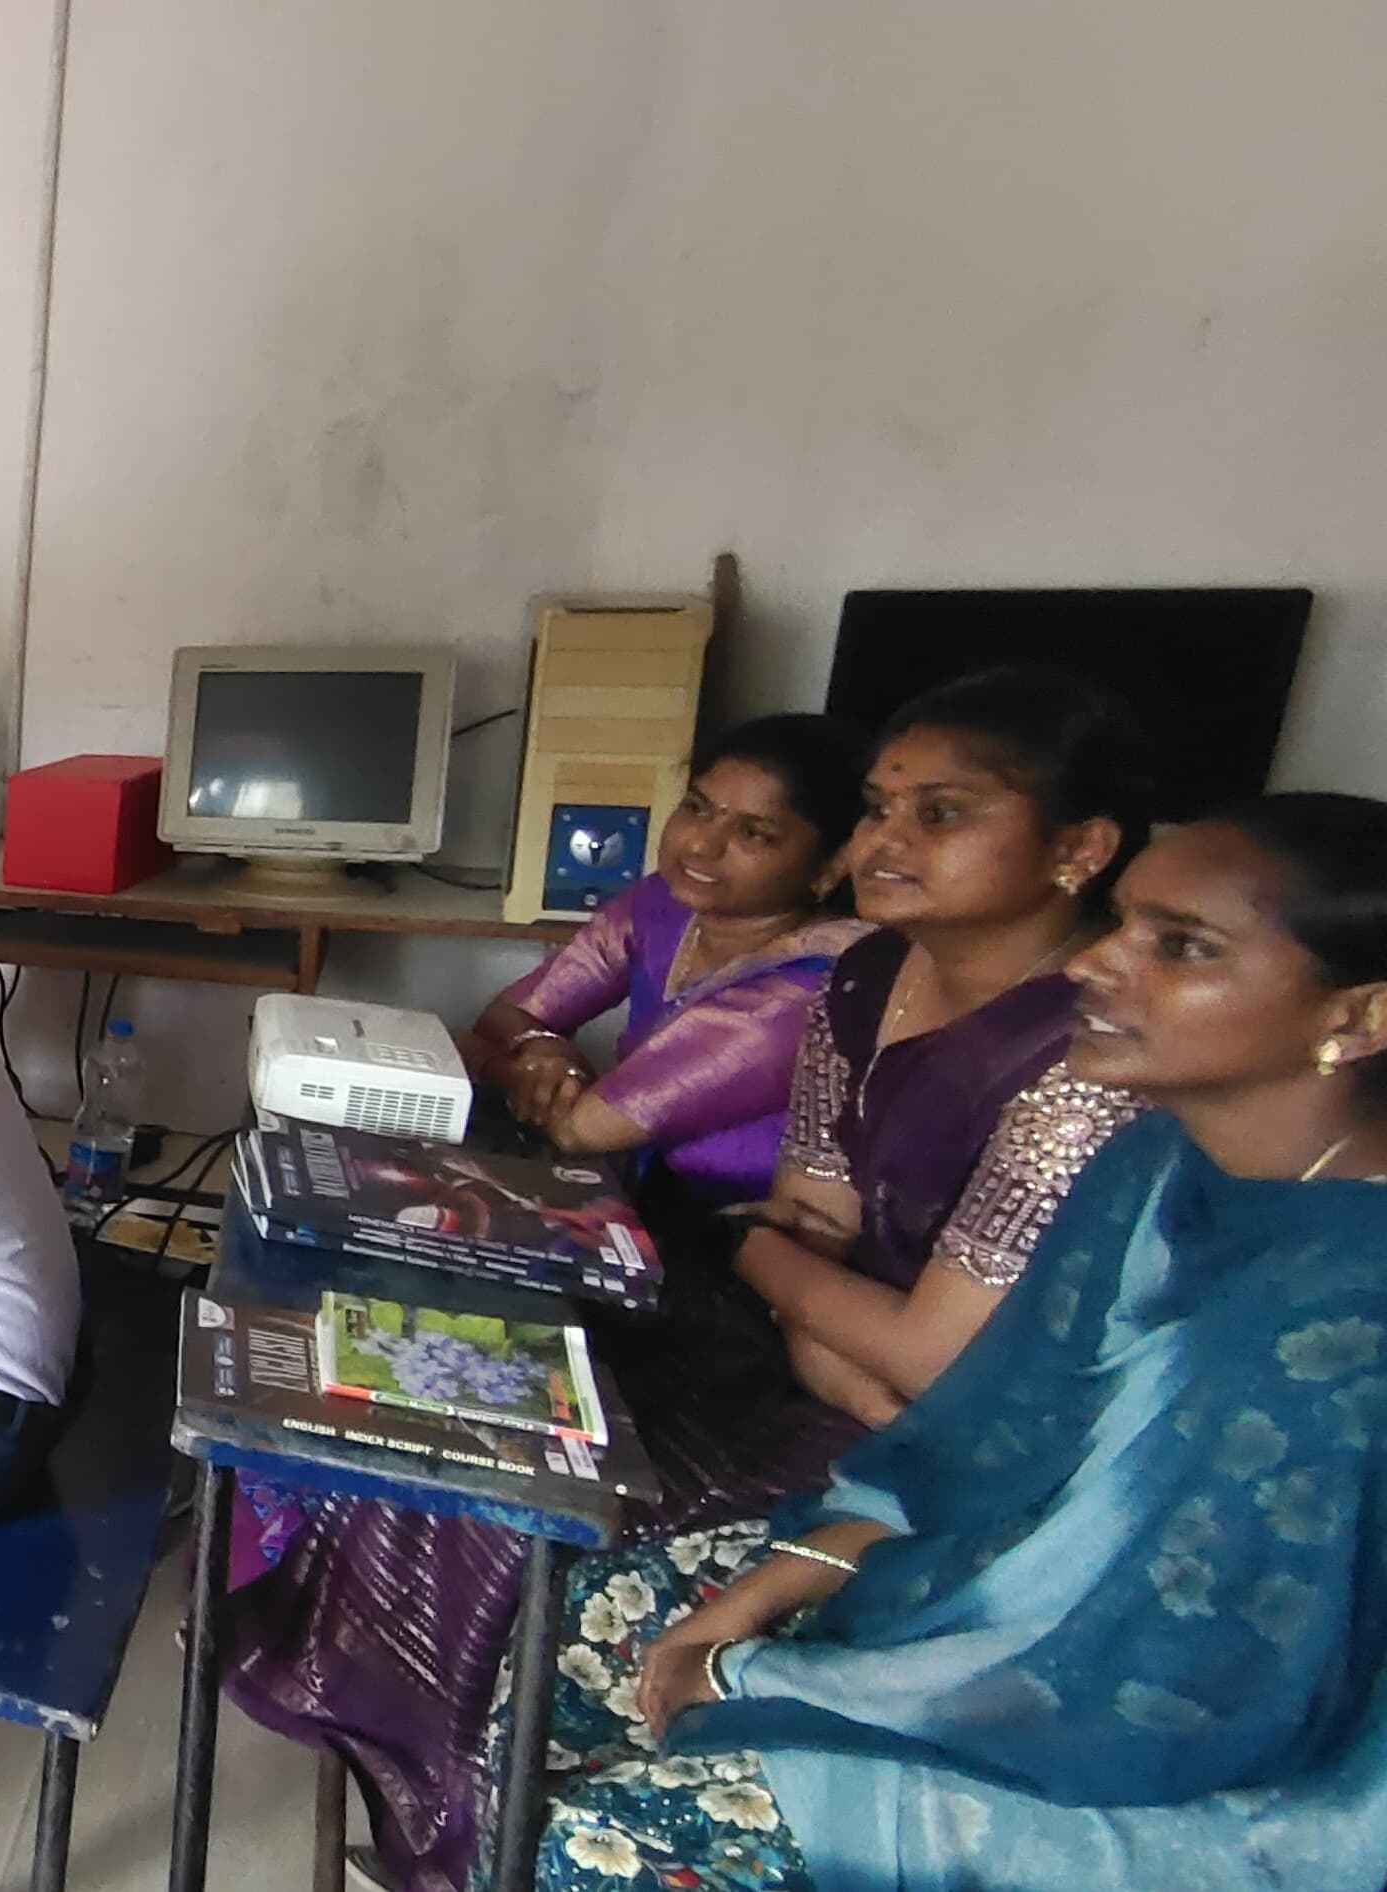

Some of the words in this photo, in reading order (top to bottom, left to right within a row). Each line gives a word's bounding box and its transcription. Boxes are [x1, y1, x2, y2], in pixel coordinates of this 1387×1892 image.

[282, 1417, 336, 1437] ENGLISH
[345, 1429, 384, 1446] INDEX
[386, 1437, 434, 1456] SCRIPT
[442, 1449, 495, 1468] COURSE
[497, 1460, 536, 1477] BOOK
